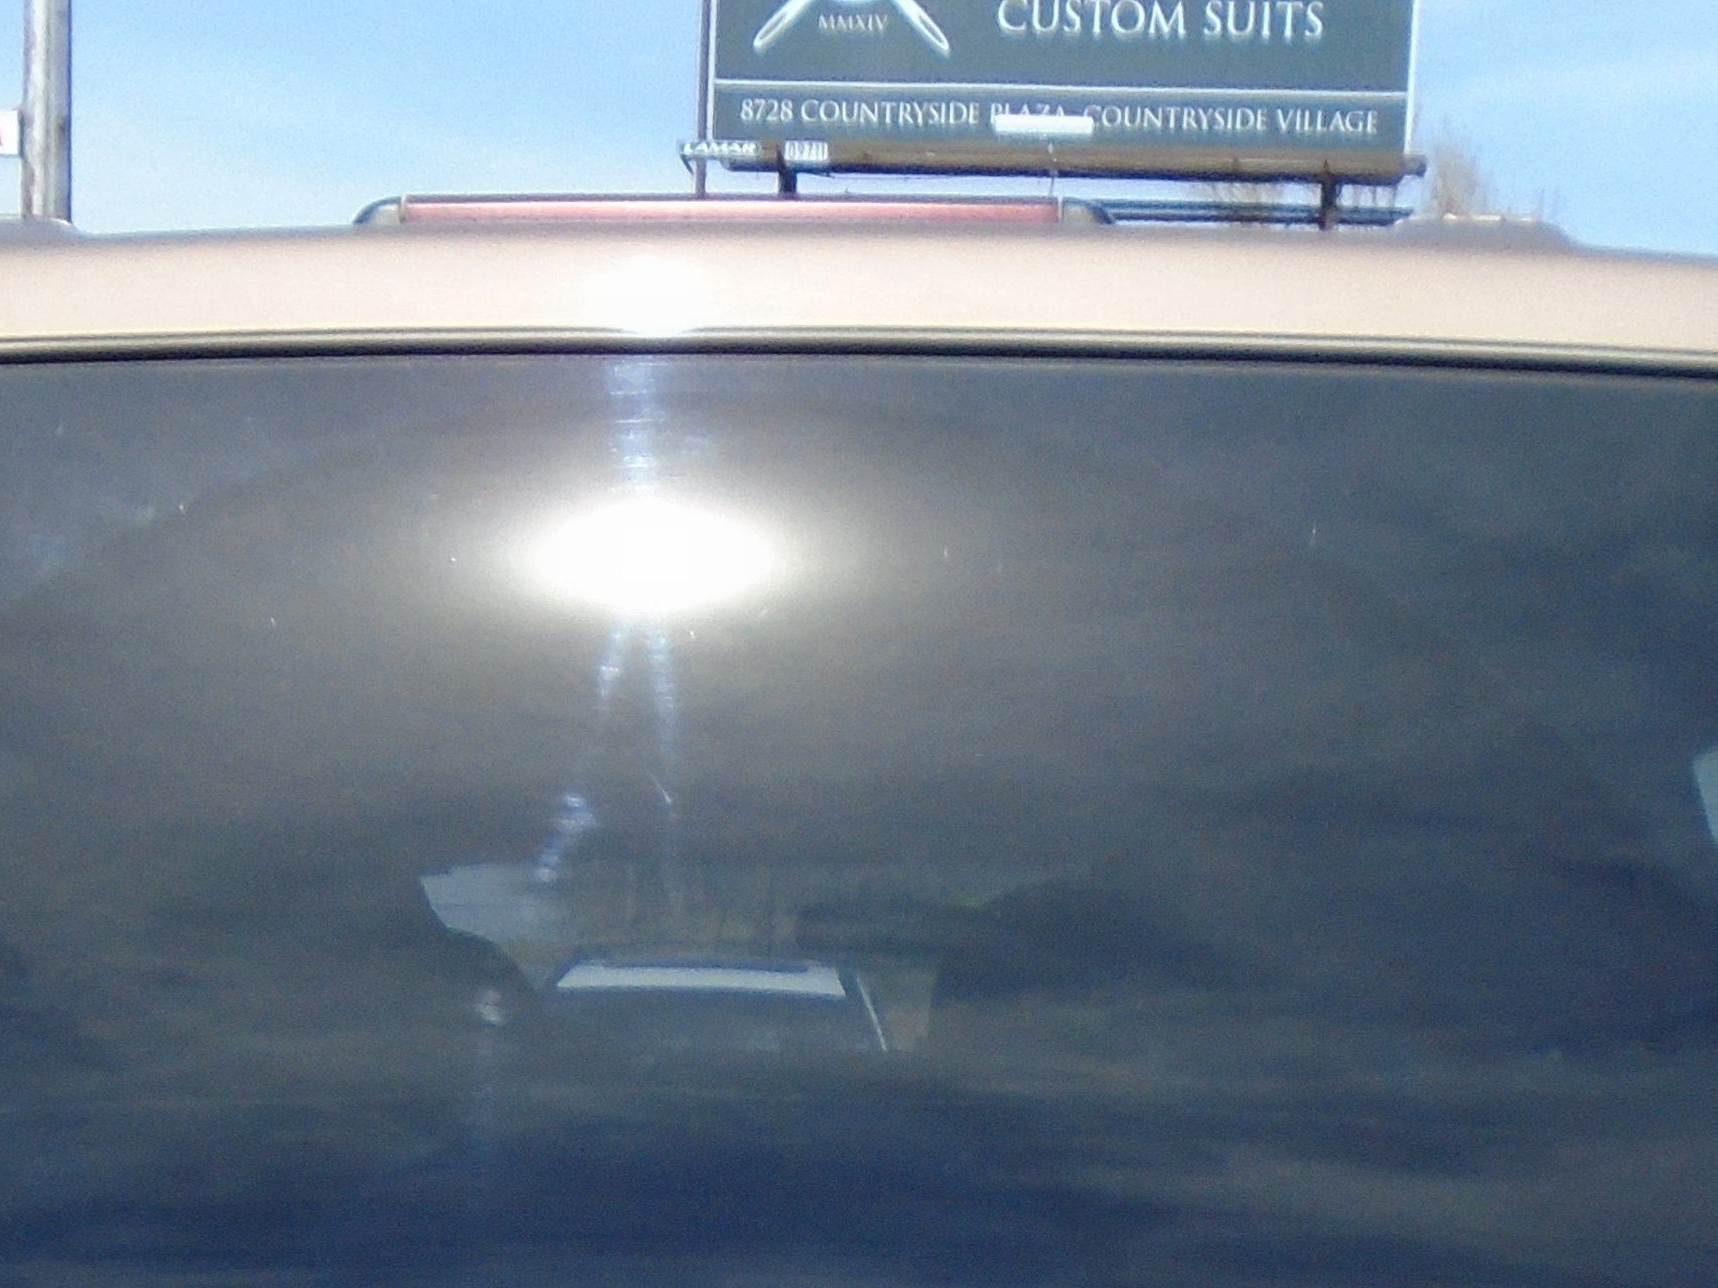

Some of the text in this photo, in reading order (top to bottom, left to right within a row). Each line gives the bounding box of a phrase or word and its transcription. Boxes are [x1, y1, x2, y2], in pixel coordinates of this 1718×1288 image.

[817, 12, 887, 33] MMXIV
[997, 0, 1324, 42] CUSTOM SUITS
[740, 98, 793, 122] 8728
[800, 98, 979, 128] COUNTRYSIDE
[1083, 103, 1267, 133] COUNTRYSIDE
[1278, 108, 1379, 136] VILLAGE
